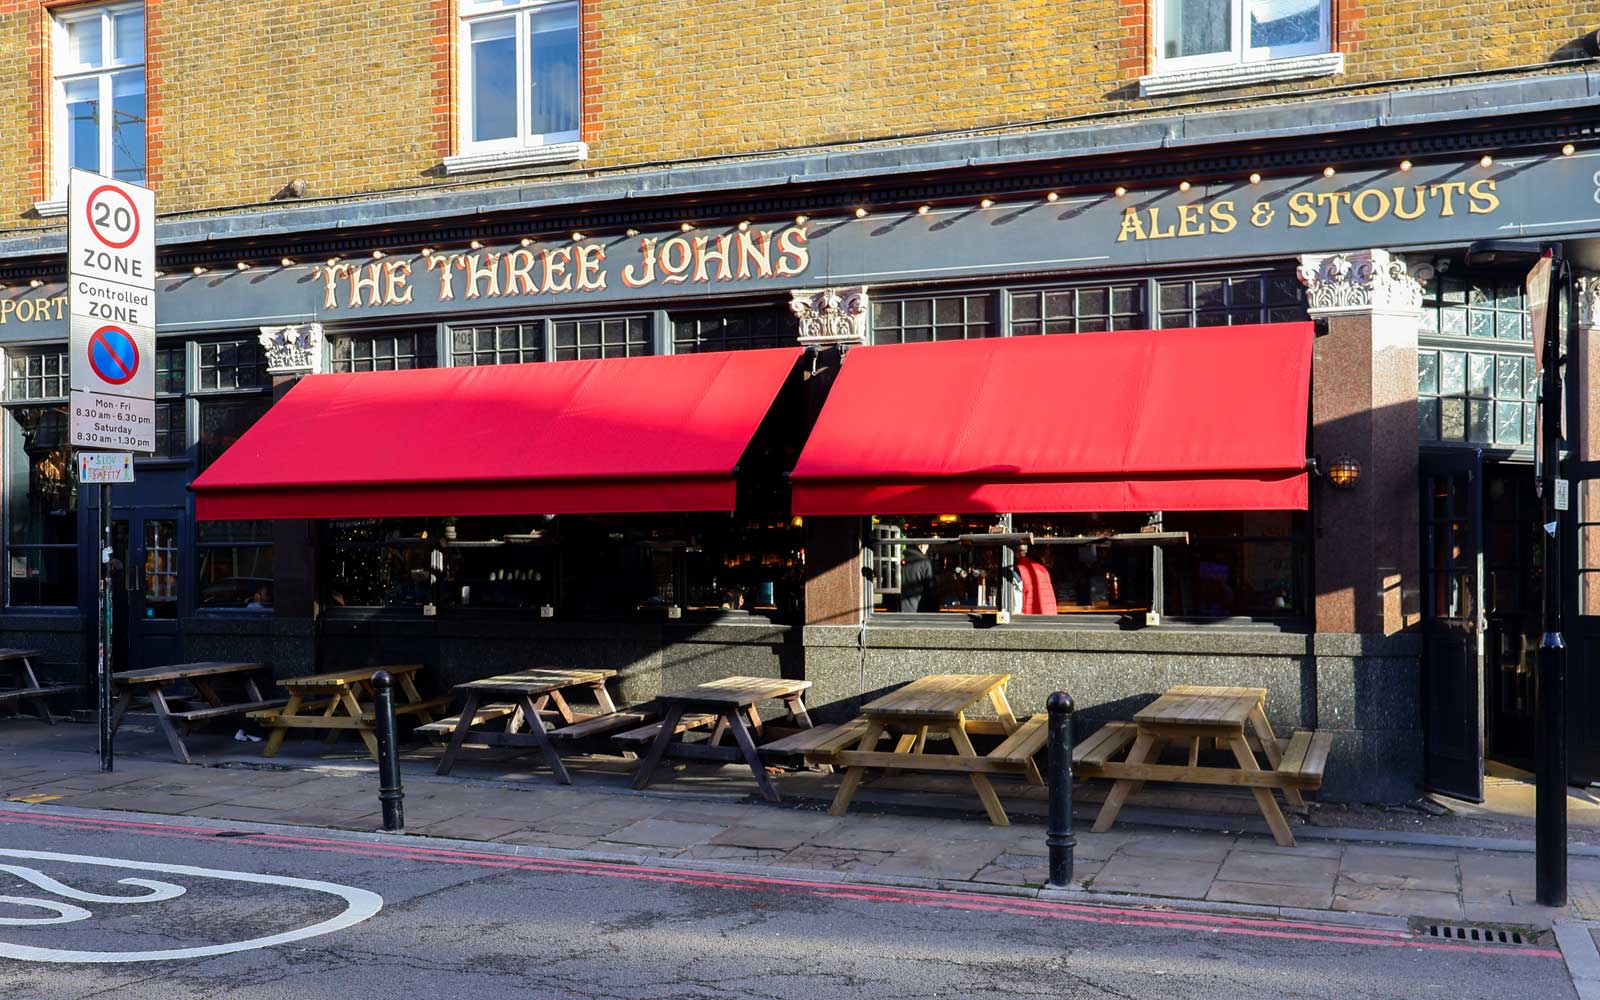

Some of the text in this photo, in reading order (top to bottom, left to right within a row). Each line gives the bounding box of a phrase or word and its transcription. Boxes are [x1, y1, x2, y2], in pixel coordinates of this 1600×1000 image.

[94, 202, 131, 232] 20
[1116, 180, 1500, 242] ALES & STOUTS
[84, 248, 143, 278] ZONE
[312, 227, 810, 309] THE THREE JOHNS
[79, 282, 148, 306] Controlled
[0, 296, 68, 324] PORT
[89, 301, 138, 324] ZONE
[76, 408, 97, 418] 8.30
[117, 413, 137, 422] 6.30
[138, 416, 151, 424] pm
[95, 399, 113, 409] Mon
[120, 402, 131, 411] Fri
[77, 432, 98, 442] 8.30
[118, 436, 136, 445] 1.30
[94, 422, 132, 435] Saturday
